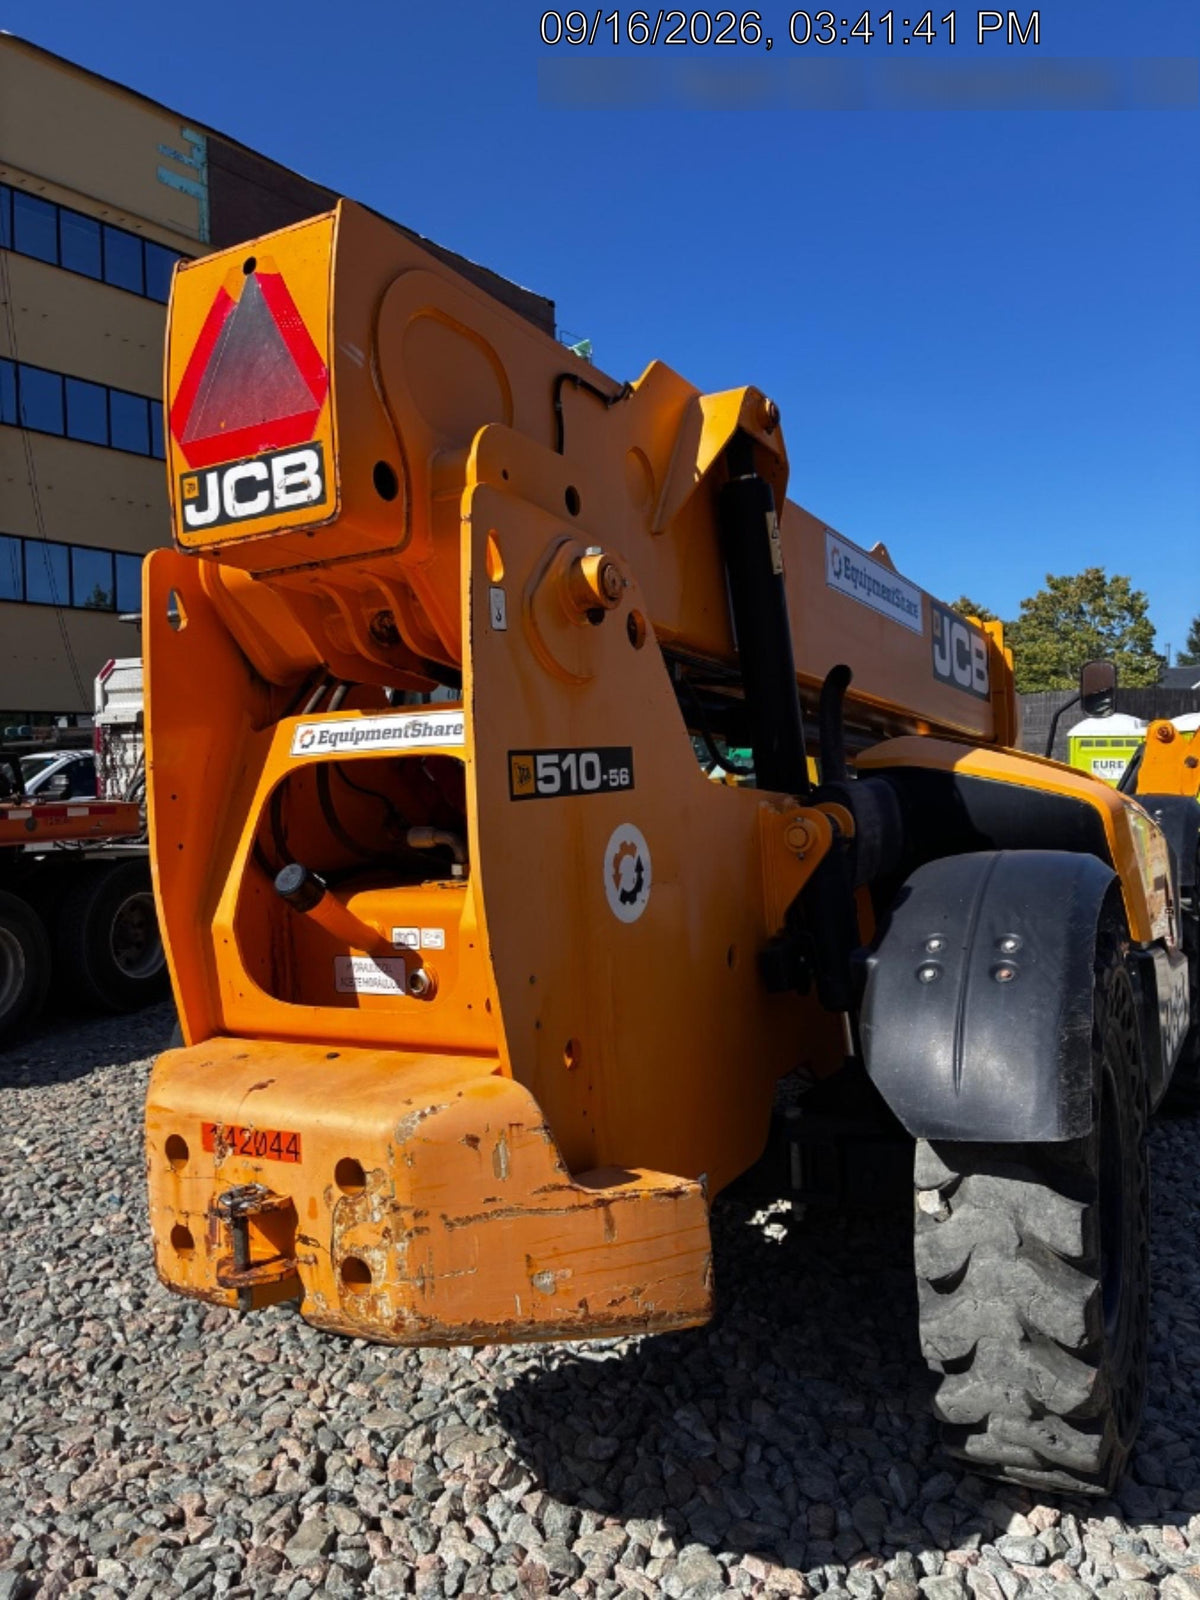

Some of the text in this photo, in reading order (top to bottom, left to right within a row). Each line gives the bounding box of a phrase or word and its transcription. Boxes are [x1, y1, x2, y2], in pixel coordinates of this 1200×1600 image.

[185, 449, 322, 526] JCB
[843, 555, 919, 620] EquipmentShare
[934, 616, 989, 695] JCB
[318, 719, 463, 747] EquipmentShare
